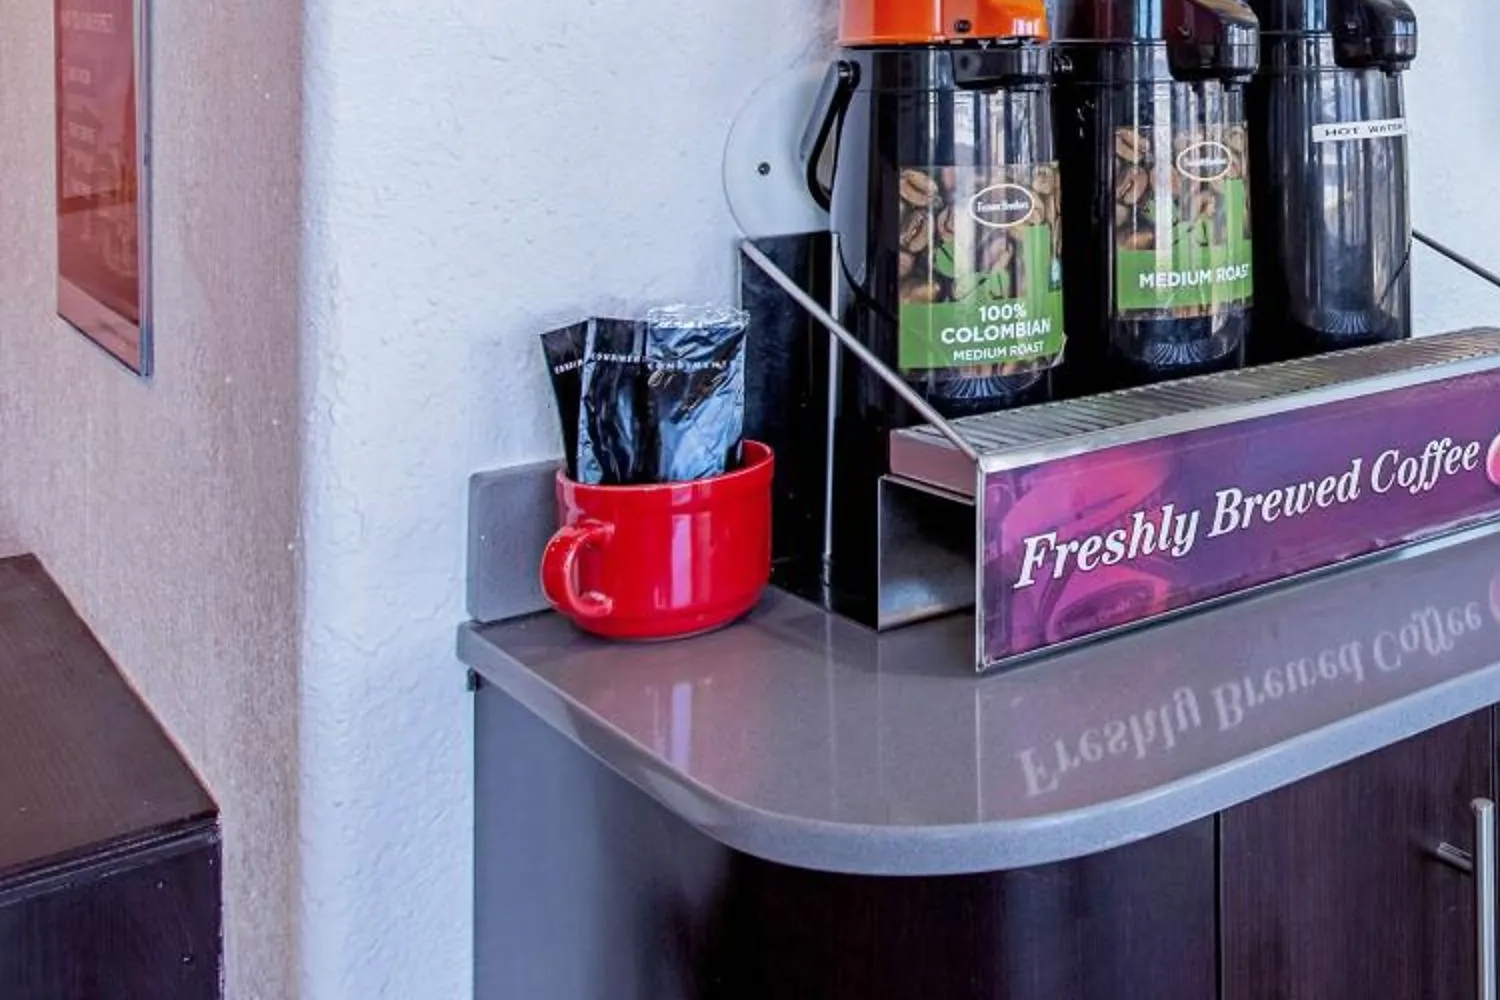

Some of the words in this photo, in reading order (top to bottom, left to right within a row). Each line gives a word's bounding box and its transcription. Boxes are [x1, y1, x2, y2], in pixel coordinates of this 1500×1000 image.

[1324, 126, 1361, 137] HOT
[1138, 268, 1213, 289] MEDIUM
[979, 301, 1027, 323] 100%
[941, 317, 1052, 345] COLOMBIAN
[953, 345, 1007, 361] MEDIUM
[1009, 340, 1045, 357] ROAST
[1011, 503, 1201, 590] Freshly
[1206, 456, 1363, 538] Brewed
[1370, 436, 1481, 495] Coffee
